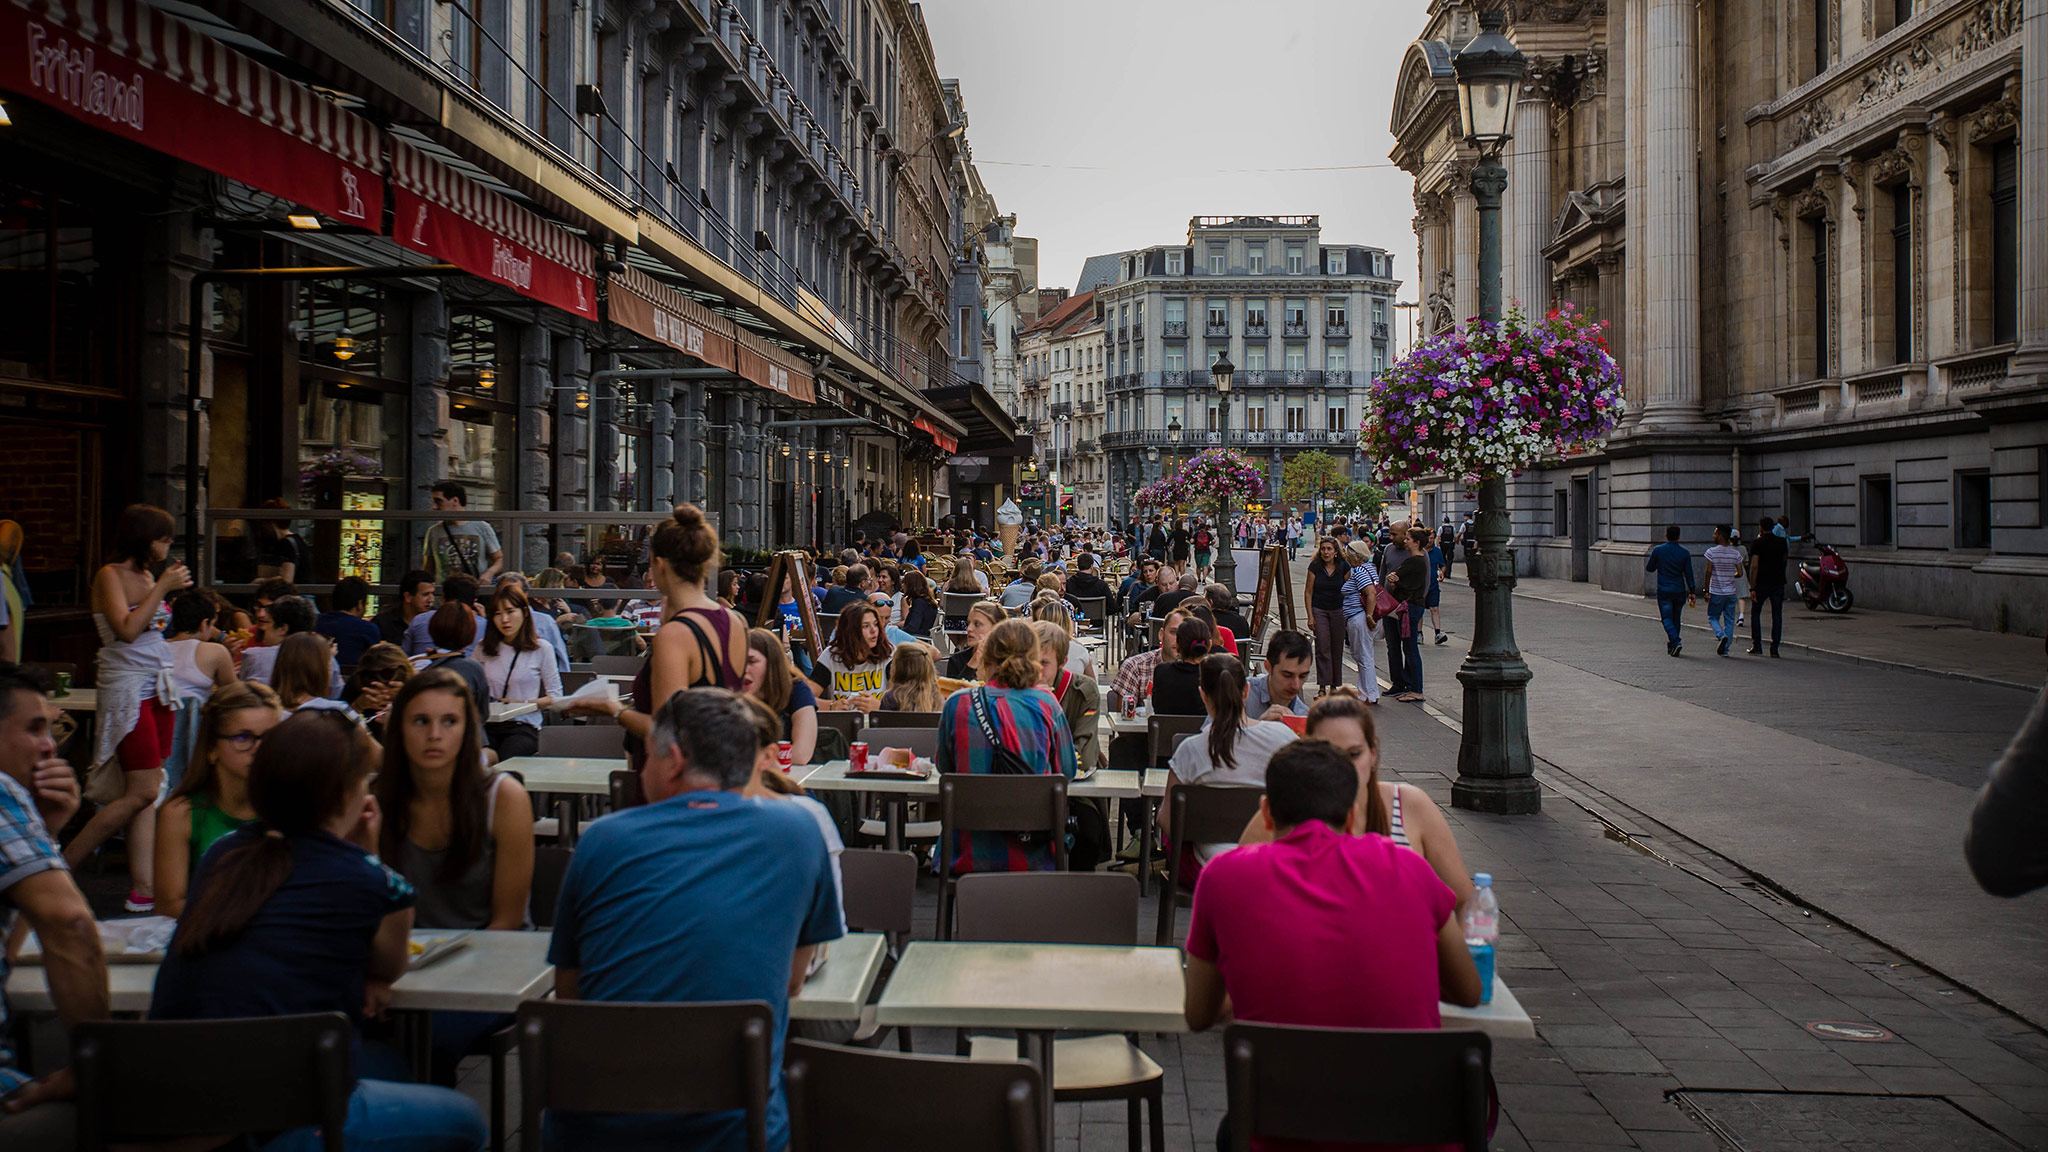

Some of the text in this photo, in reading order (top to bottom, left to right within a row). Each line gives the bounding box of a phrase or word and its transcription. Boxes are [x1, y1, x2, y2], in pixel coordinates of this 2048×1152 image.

[27, 21, 144, 131] Fritland
[492, 238, 532, 290] Fritland
[835, 669, 883, 692] NEW
